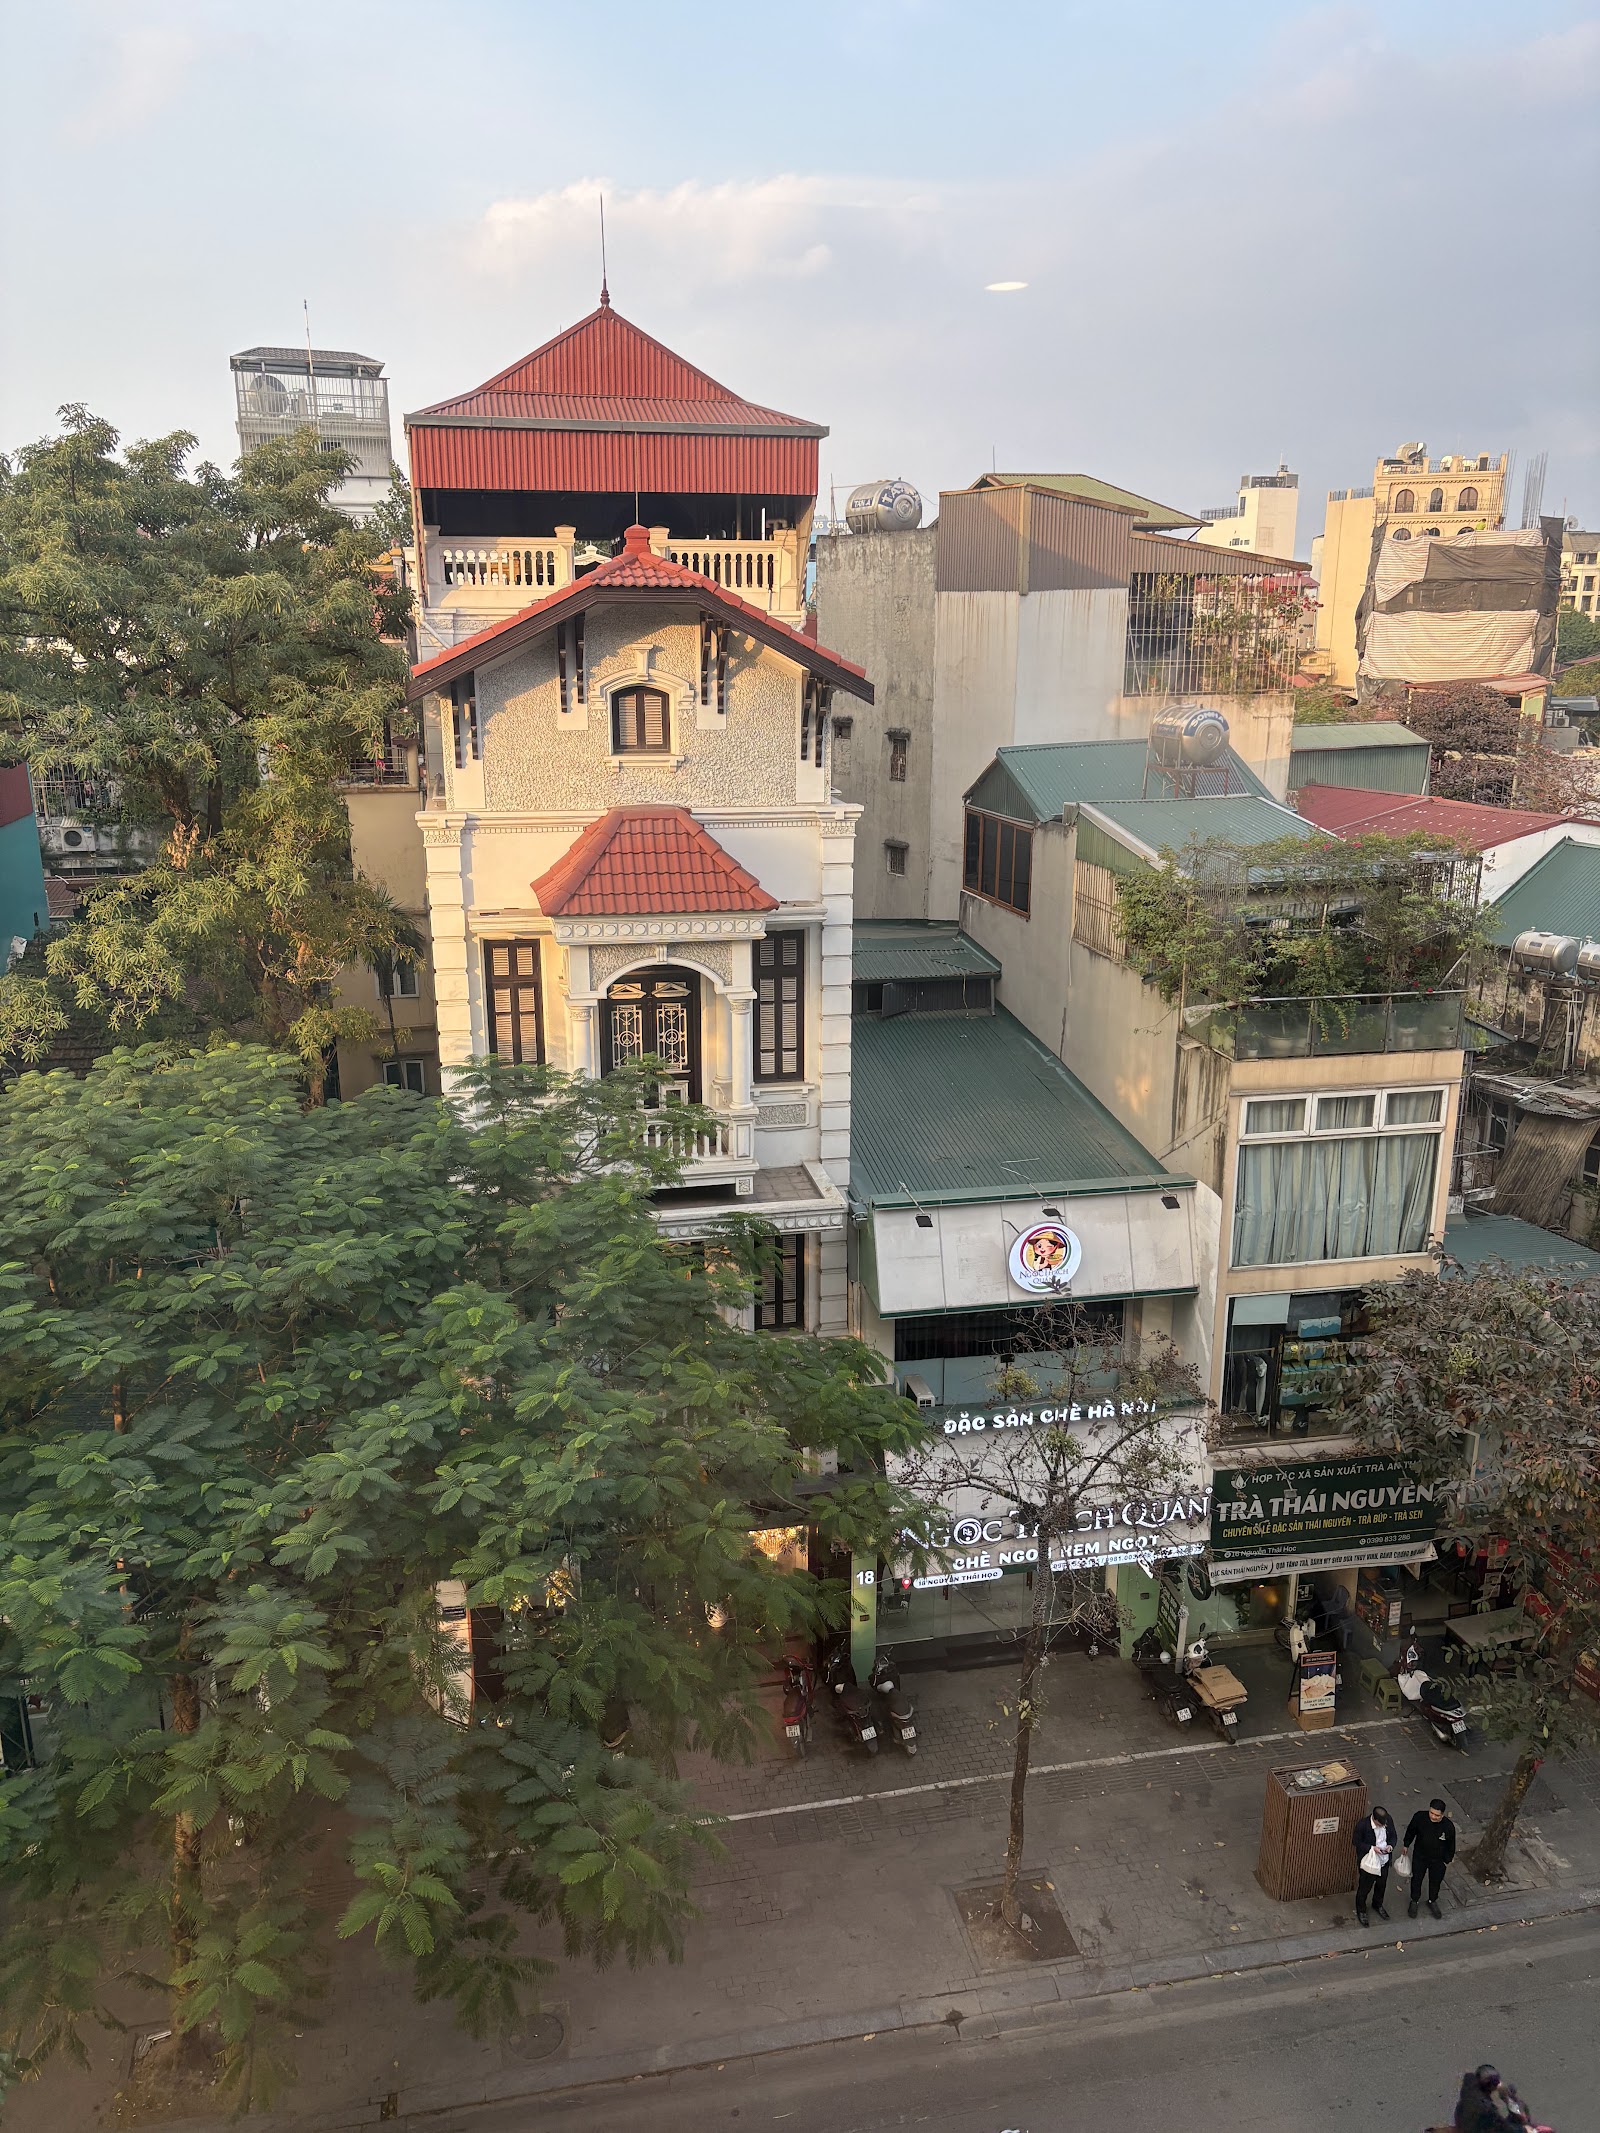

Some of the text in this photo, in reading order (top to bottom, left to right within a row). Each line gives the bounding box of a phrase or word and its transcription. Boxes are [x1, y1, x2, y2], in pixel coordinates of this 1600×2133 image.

[944, 1411, 986, 1436] ĐẶC
[992, 1408, 1034, 1429] SẢN
[1040, 1402, 1081, 1424] CHÈ
[1088, 1399, 1115, 1419] HÀ
[1251, 1473, 1273, 1484] HỢP
[1275, 1470, 1296, 1481] TÁC
[1297, 1468, 1311, 1479] XÃ
[1313, 1465, 1334, 1478] SẢN
[1336, 1462, 1363, 1476] XUẤT
[1365, 1461, 1385, 1473] TRÀ
[1216, 1479, 1434, 1522] TRÀ THÁI NGUYÊN
[1009, 1507, 1115, 1539] TCH
[1122, 1496, 1209, 1528] QUÁN
[1222, 1525, 1253, 1538] CHUYÊN
[1272, 1521, 1288, 1535] ĐẶC
[1288, 1519, 1304, 1532] SẢN
[1305, 1518, 1321, 1530] THÁI
[1322, 1515, 1352, 1529] NGUYÊN
[1358, 1513, 1372, 1525] TRÀ
[1372, 1511, 1388, 1524] BÚP
[1393, 1511, 1408, 1522] TRÀ
[1408, 1509, 1424, 1520] SEN
[952, 1550, 991, 1571] CHÈ
[999, 1546, 1052, 1565] NGO
[856, 1570, 875, 1585] 18
[981, 1571, 998, 1580] HỌC
